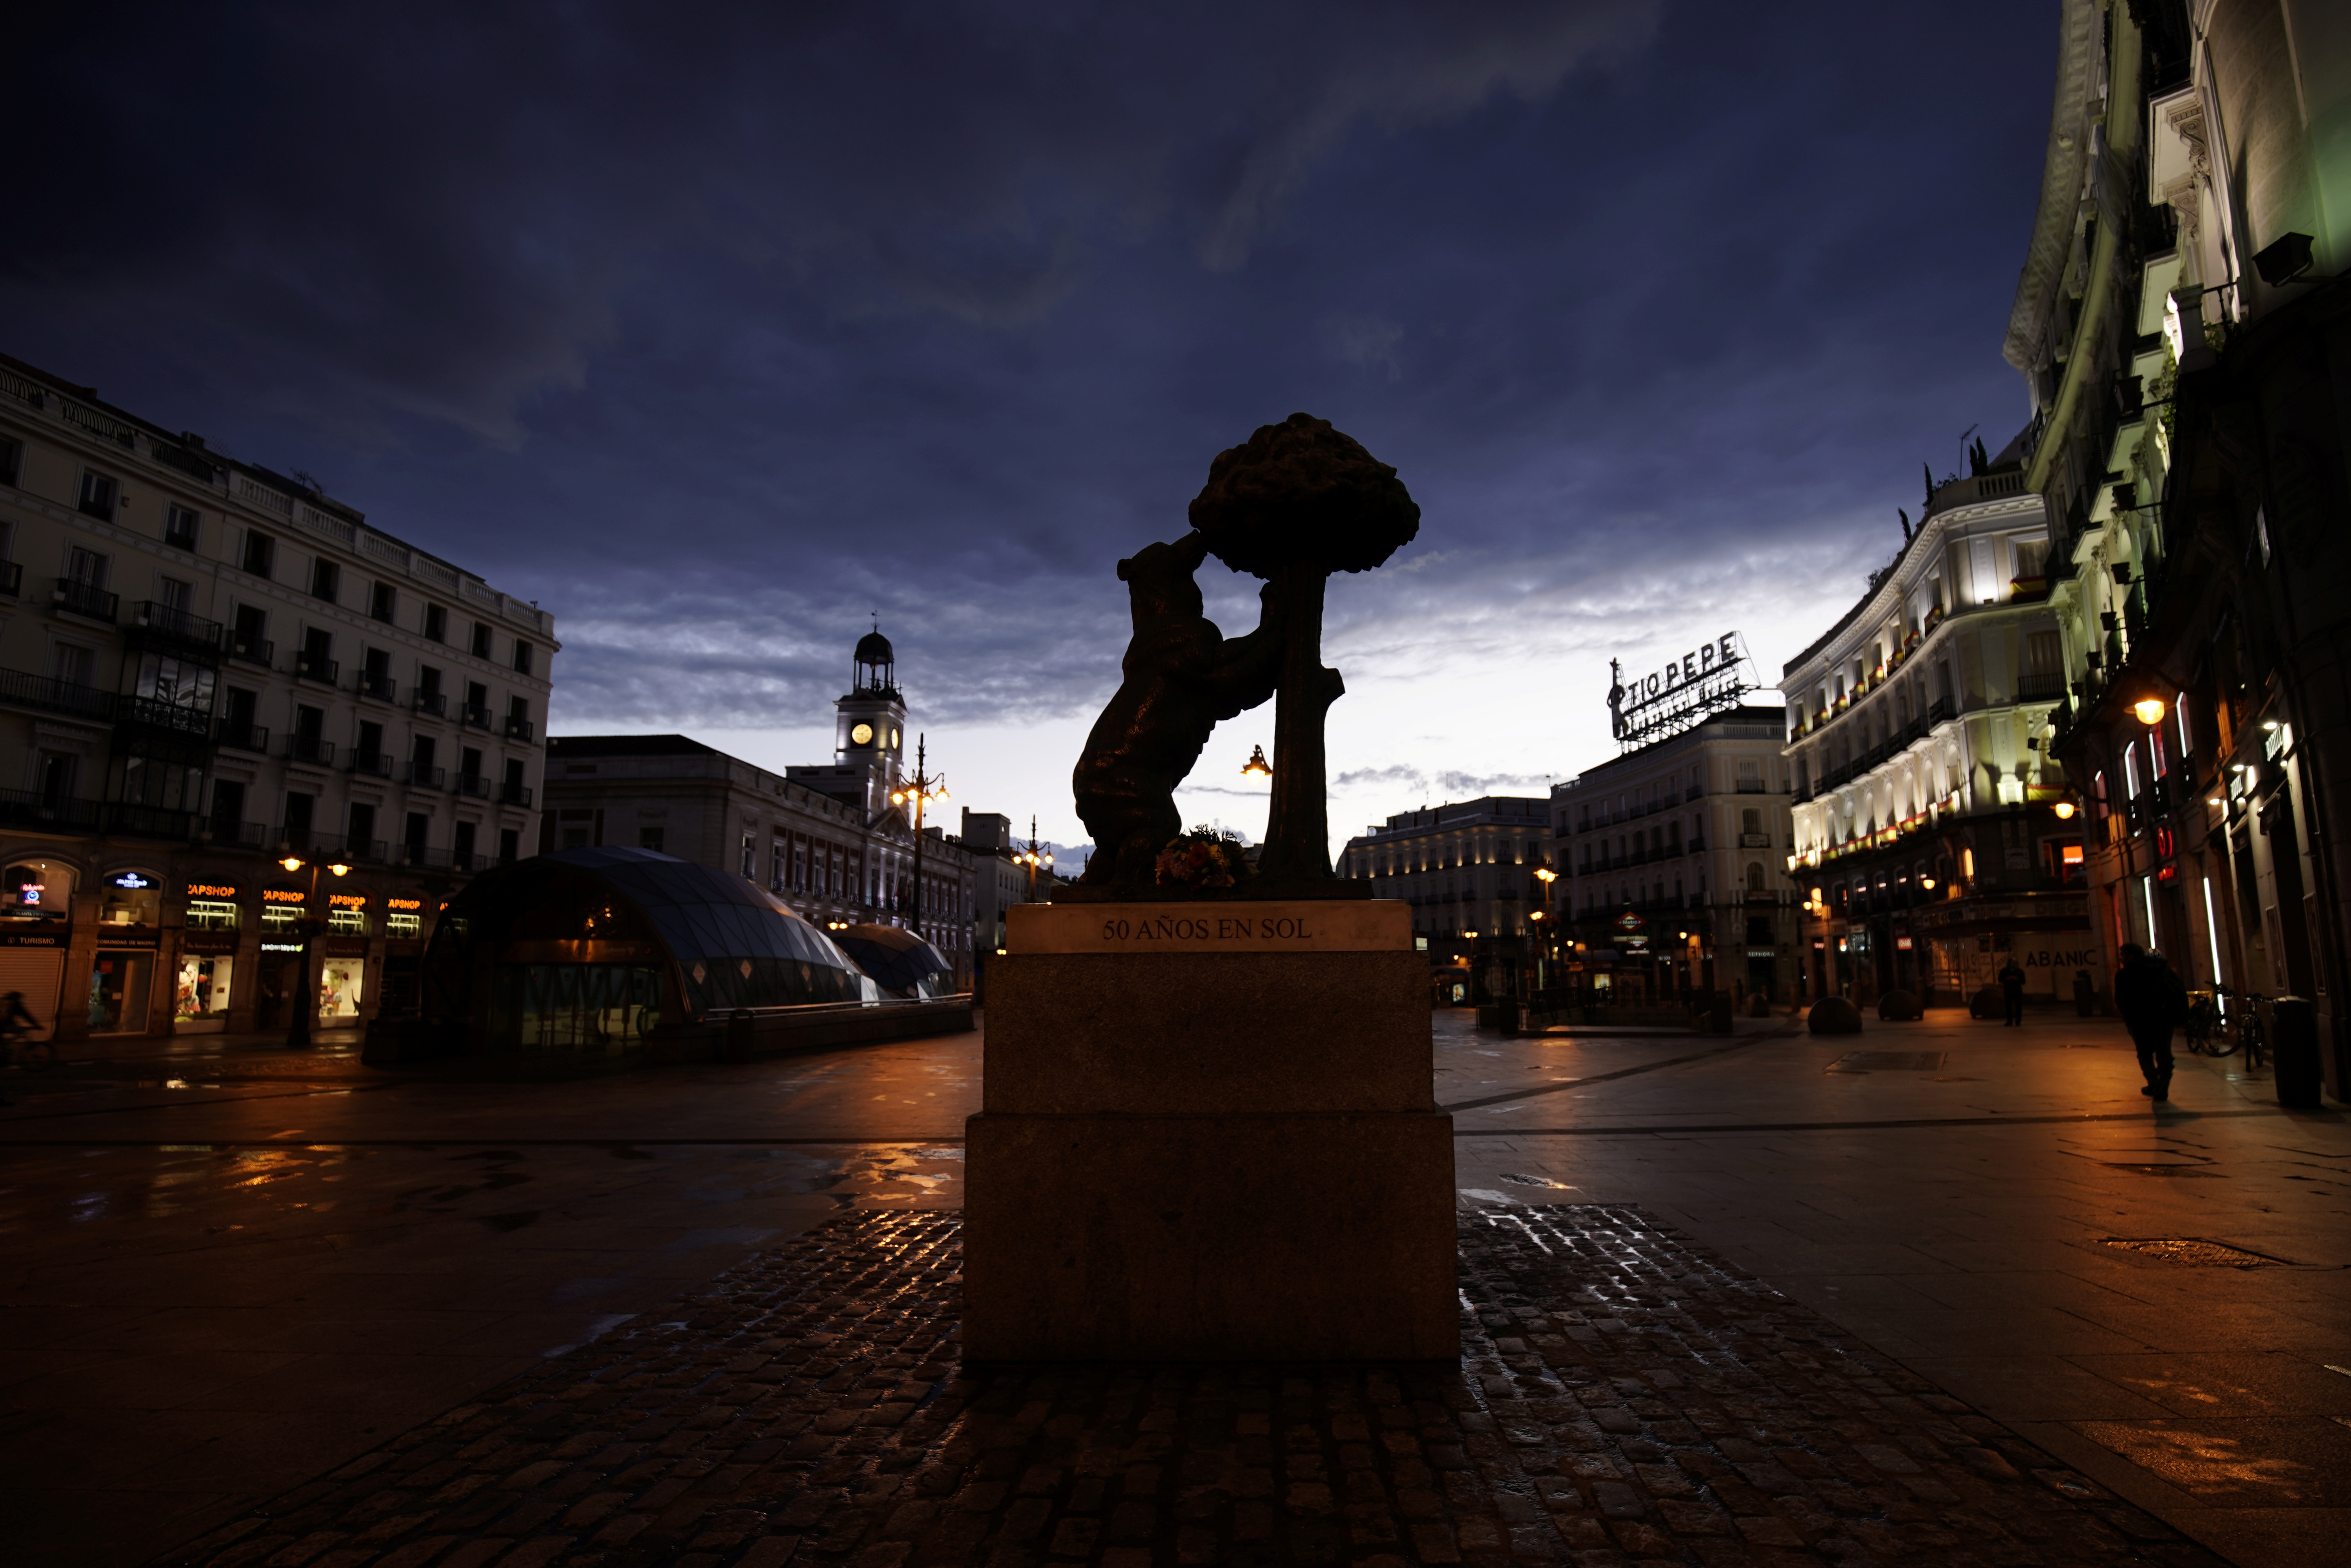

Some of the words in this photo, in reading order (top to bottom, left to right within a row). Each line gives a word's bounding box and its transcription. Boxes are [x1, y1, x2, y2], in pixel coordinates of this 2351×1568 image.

[1628, 673, 1659, 705] TIO
[1666, 631, 1734, 688] PEPE
[388, 898, 421, 910] APSHOP
[1103, 920, 1129, 940] 50
[1135, 915, 1209, 939] AÑOS
[1217, 919, 1253, 938] EN
[1261, 919, 1312, 939] SOL
[19, 937, 55, 945] TURISMO
[2026, 949, 2097, 967] ABANIC
